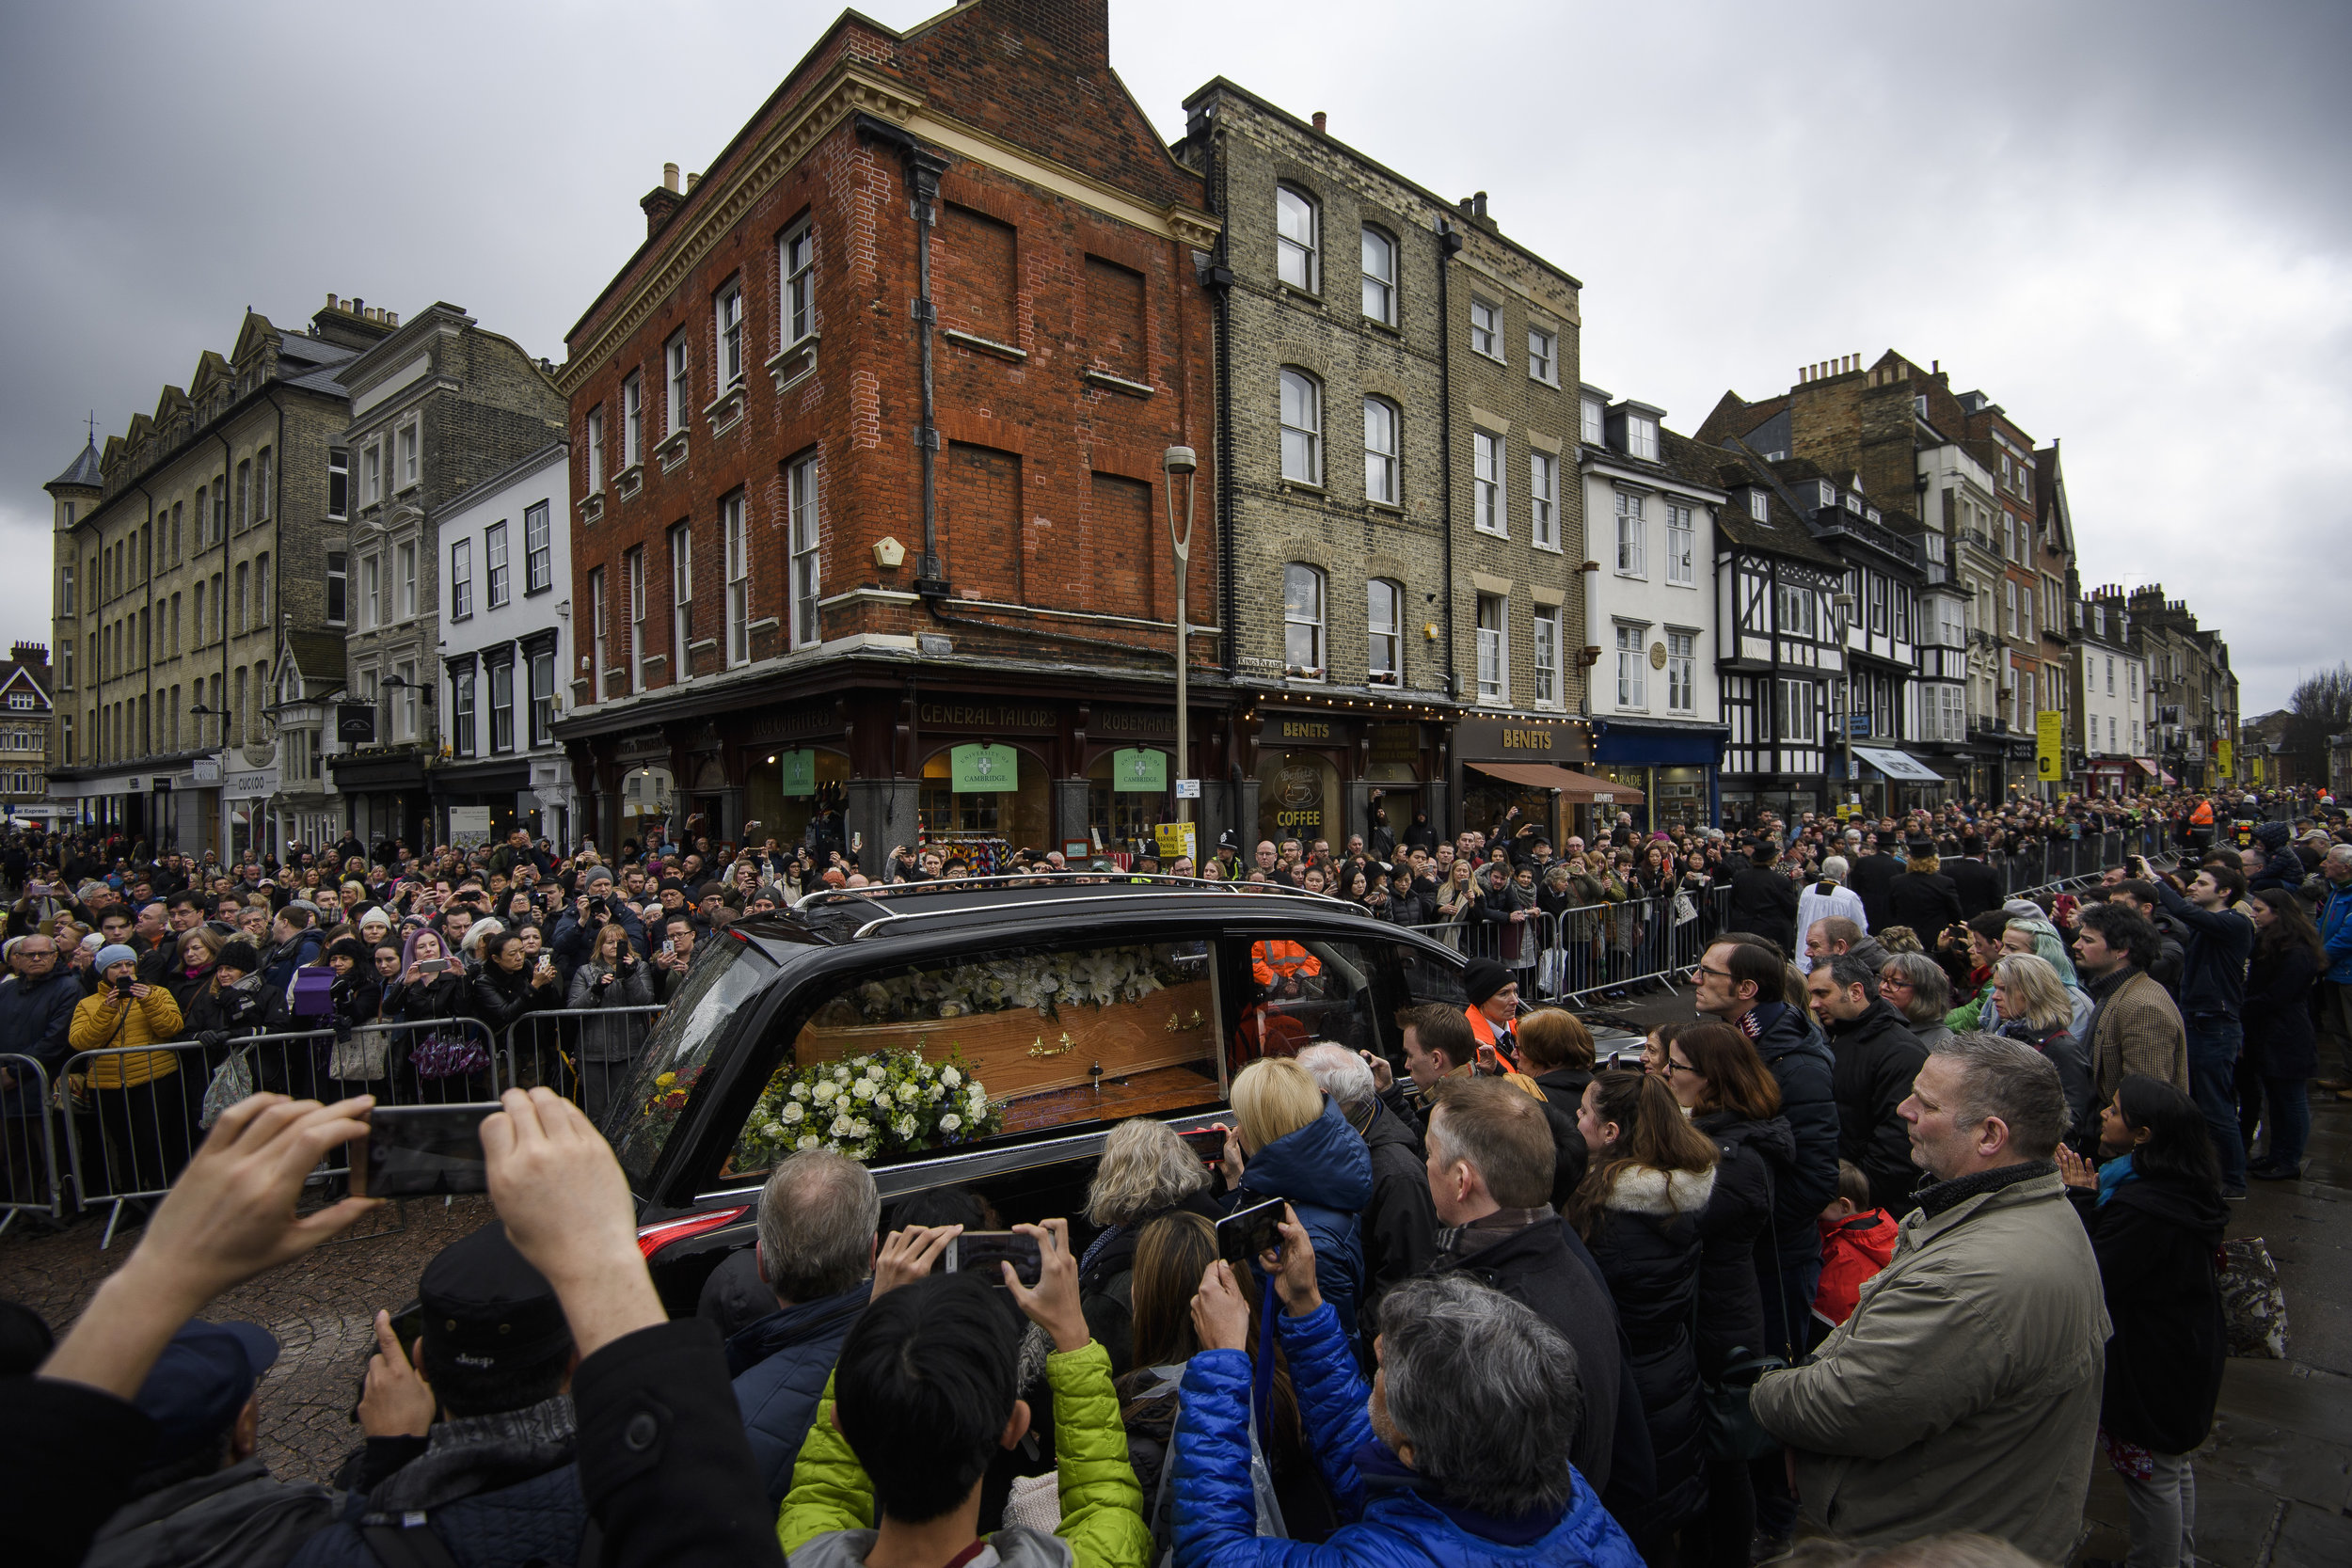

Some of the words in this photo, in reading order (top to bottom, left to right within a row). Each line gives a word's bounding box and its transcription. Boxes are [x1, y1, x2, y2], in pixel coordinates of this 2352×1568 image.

[1259, 658, 1281, 668] PARADE
[921, 704, 994, 725] GENERAL
[997, 706, 1057, 727] TAILORS
[1282, 721, 1330, 738] BENETS
[1502, 728, 1552, 750] BENETS
[1610, 774, 1642, 786] PARADE
[1277, 811, 1320, 827] COFFEE
[1296, 828, 1302, 838] &
[455, 1353, 494, 1368] Jeep
